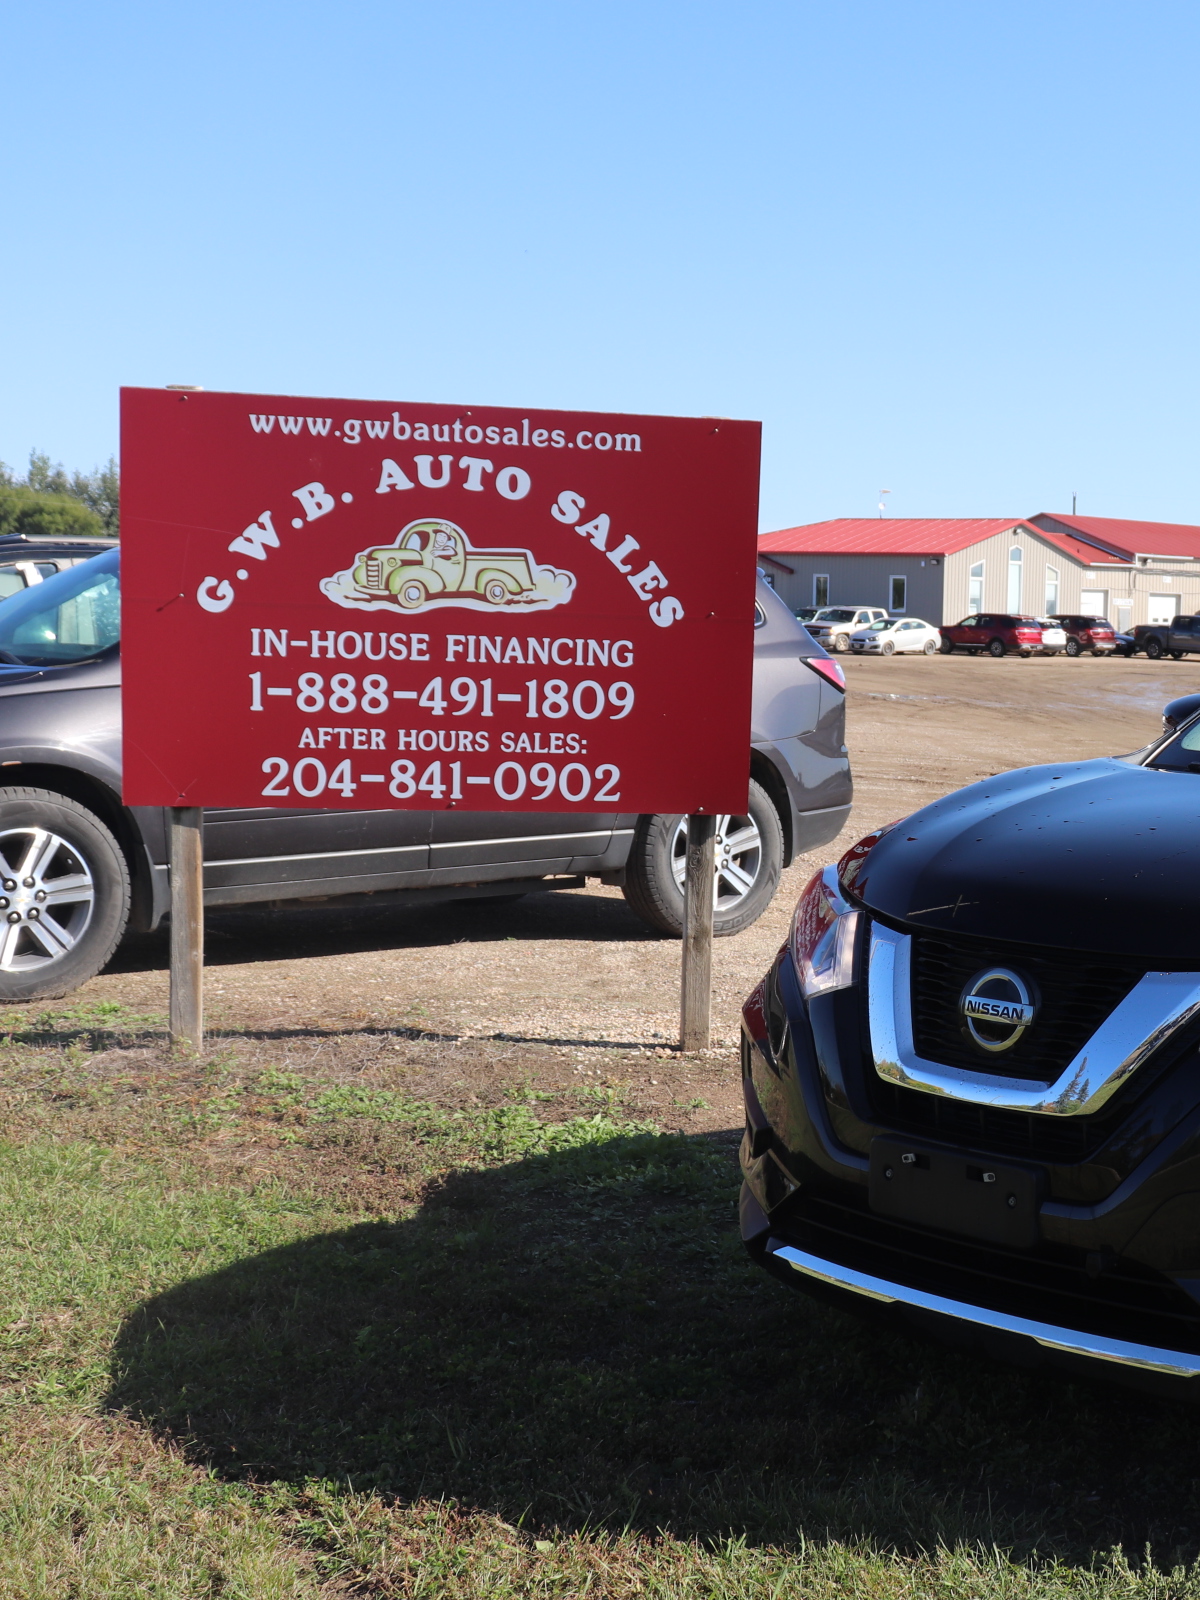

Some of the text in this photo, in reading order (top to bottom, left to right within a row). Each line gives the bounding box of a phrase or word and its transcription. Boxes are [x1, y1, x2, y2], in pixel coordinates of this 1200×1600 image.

[249, 411, 642, 453] www.gwbautosales.com
[196, 454, 685, 628] G.W.B. AUTO SALES
[250, 628, 635, 667] IN-HOUSE FINANCING
[248, 671, 635, 720] 1-888-491-1809
[297, 727, 588, 755] AFTER HOURS SALES:
[260, 756, 622, 802] 204-841-0902
[713, 903, 761, 931] COOPE
[966, 1000, 1024, 1020] NISSAN
